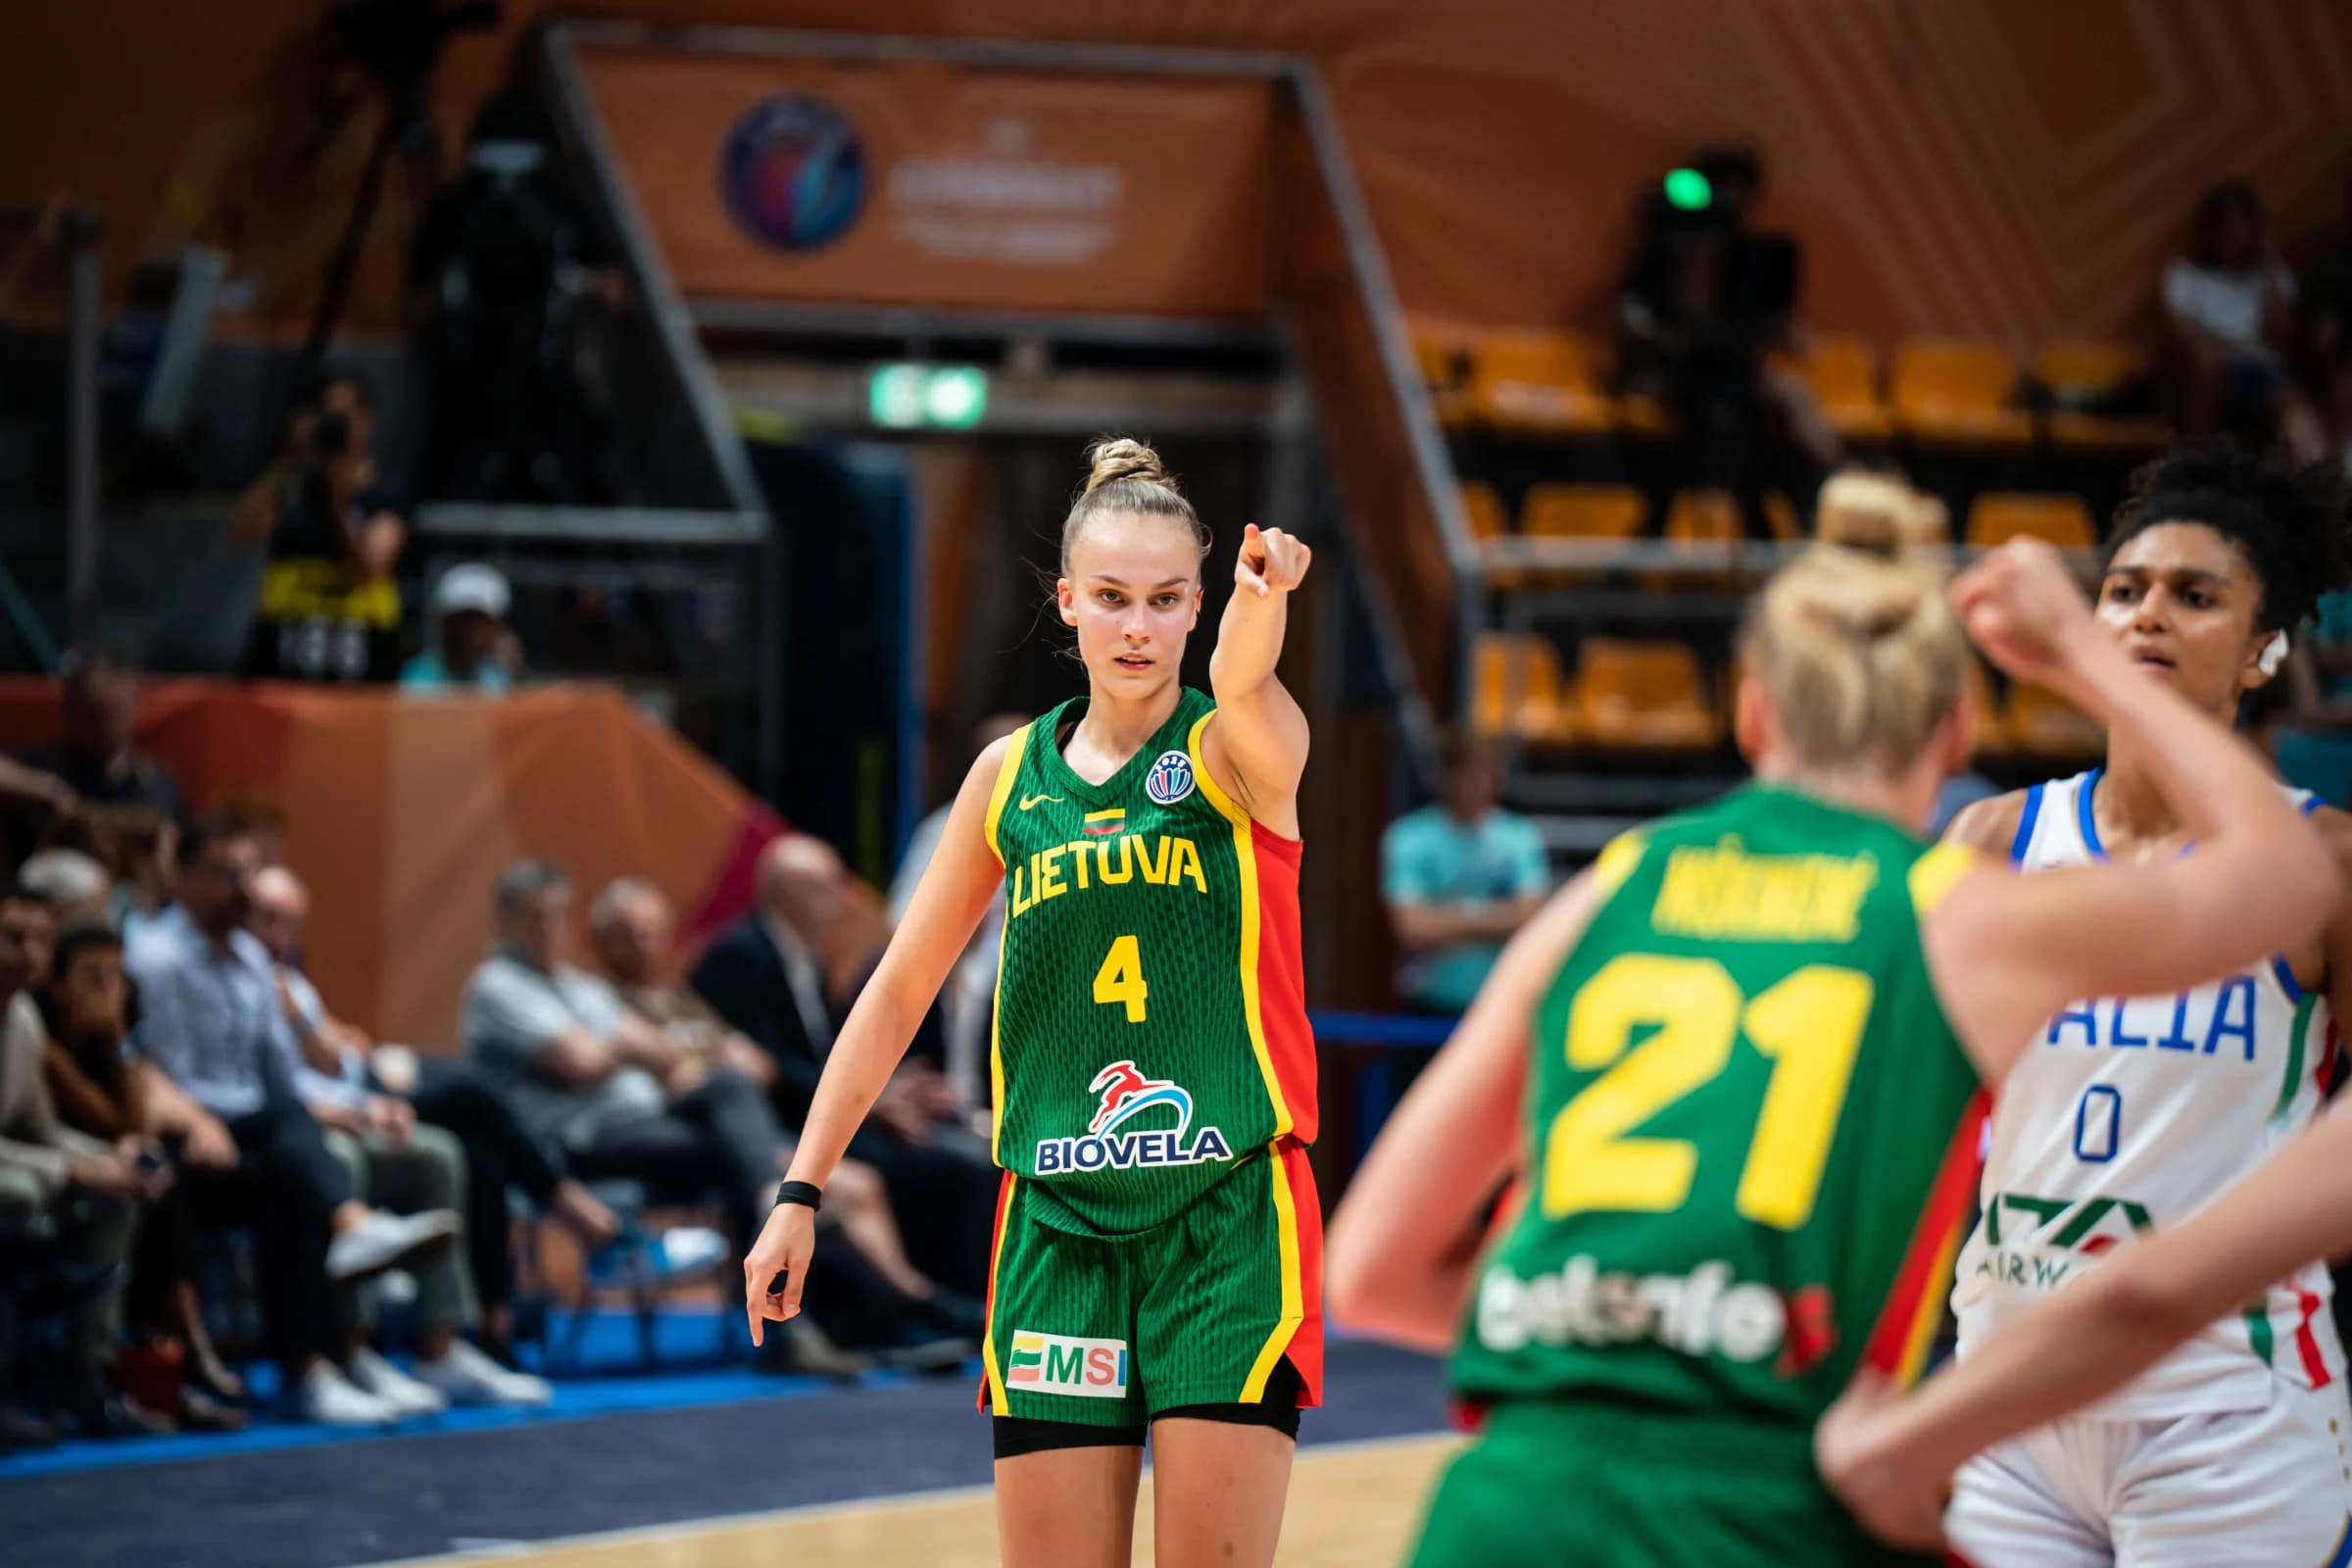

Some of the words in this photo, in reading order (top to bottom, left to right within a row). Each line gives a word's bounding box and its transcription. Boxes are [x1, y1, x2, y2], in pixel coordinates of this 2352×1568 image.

[1012, 834, 1207, 918] LIETUVA
[1093, 934, 1148, 1023] 4
[2047, 975, 2256, 1061] ALIA
[1542, 952, 1876, 1233] 21
[2073, 1084, 2121, 1163] 0
[1038, 1130, 1230, 1172] BIOVELA
[1976, 1250, 2071, 1286] AIRW
